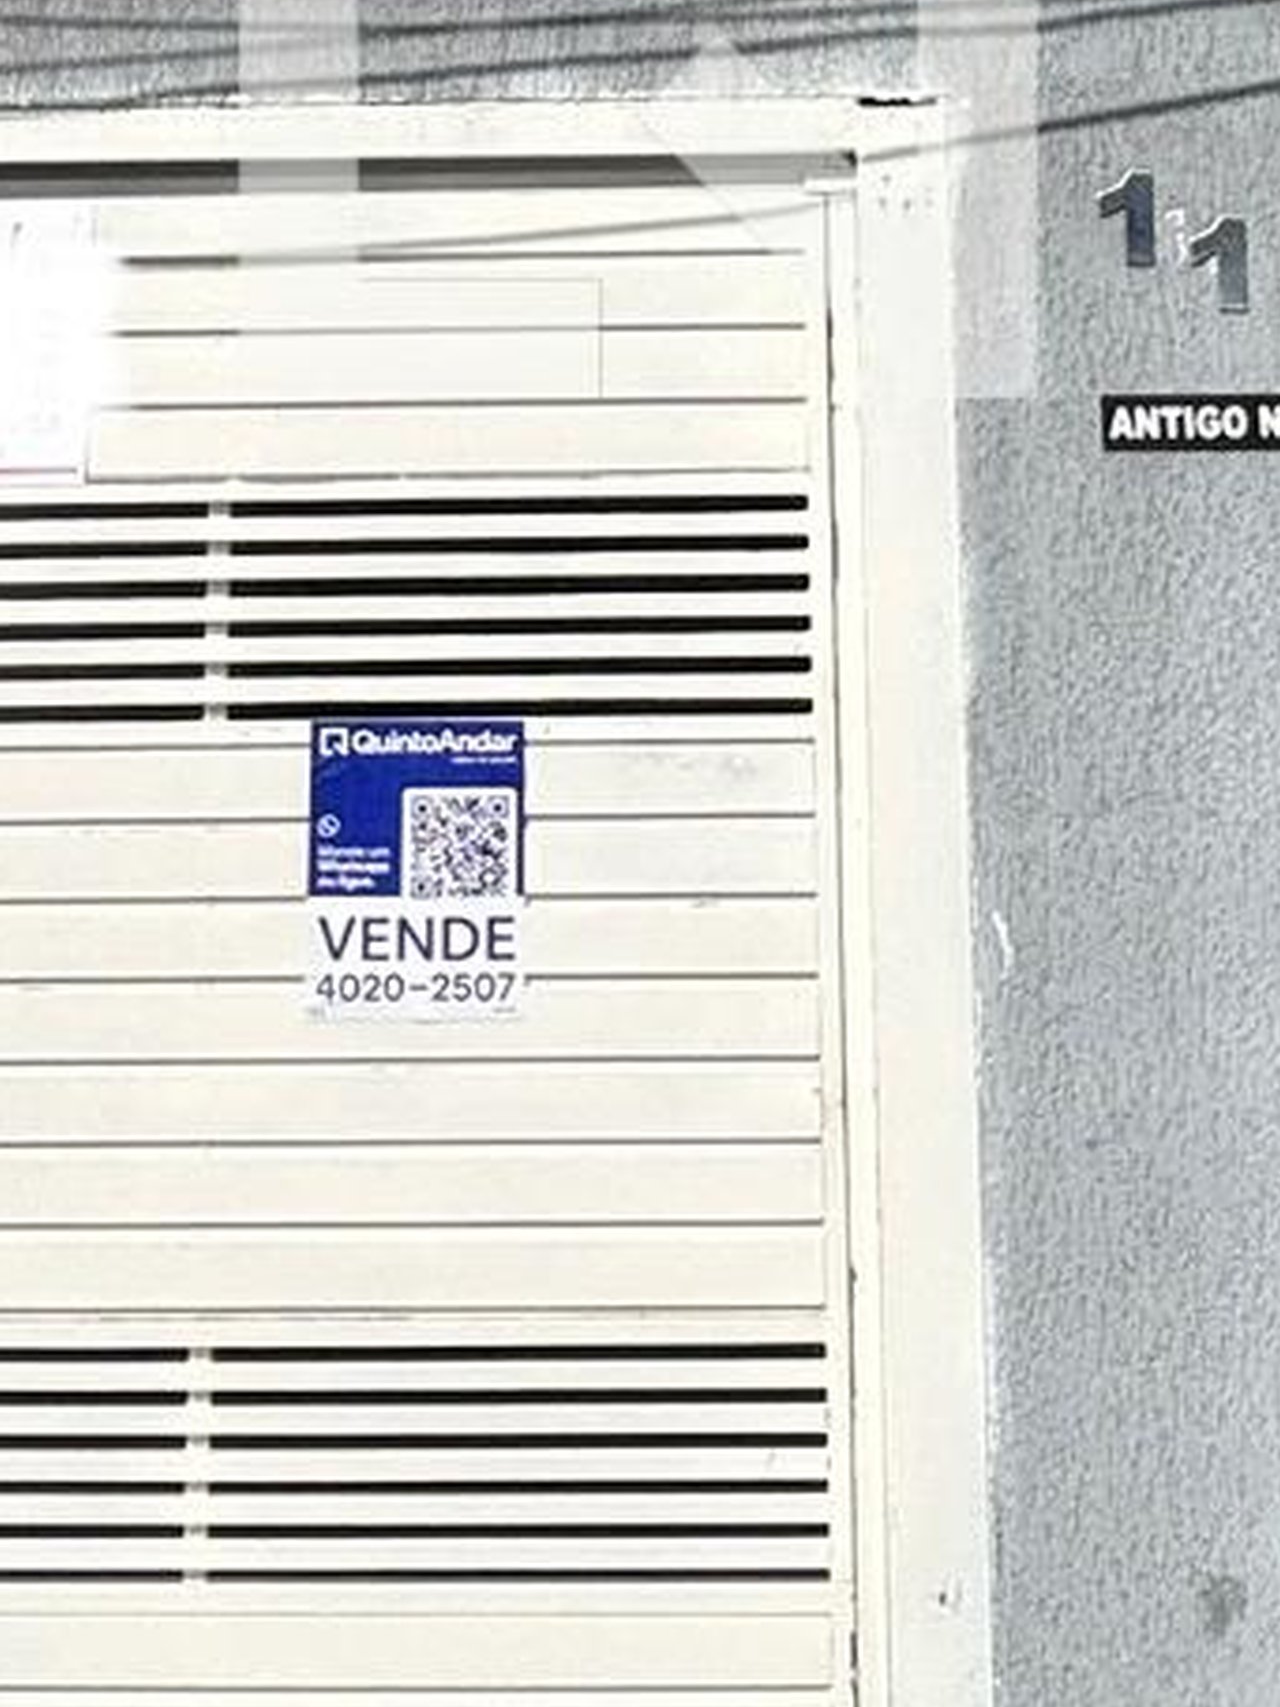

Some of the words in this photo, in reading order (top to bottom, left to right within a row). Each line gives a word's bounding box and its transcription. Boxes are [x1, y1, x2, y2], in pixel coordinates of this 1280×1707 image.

[1108, 403, 1248, 441] ANTIGO
[351, 728, 518, 755] QuintoAndar
[317, 916, 516, 962] VENDE
[316, 972, 517, 1003] 4020-2507
